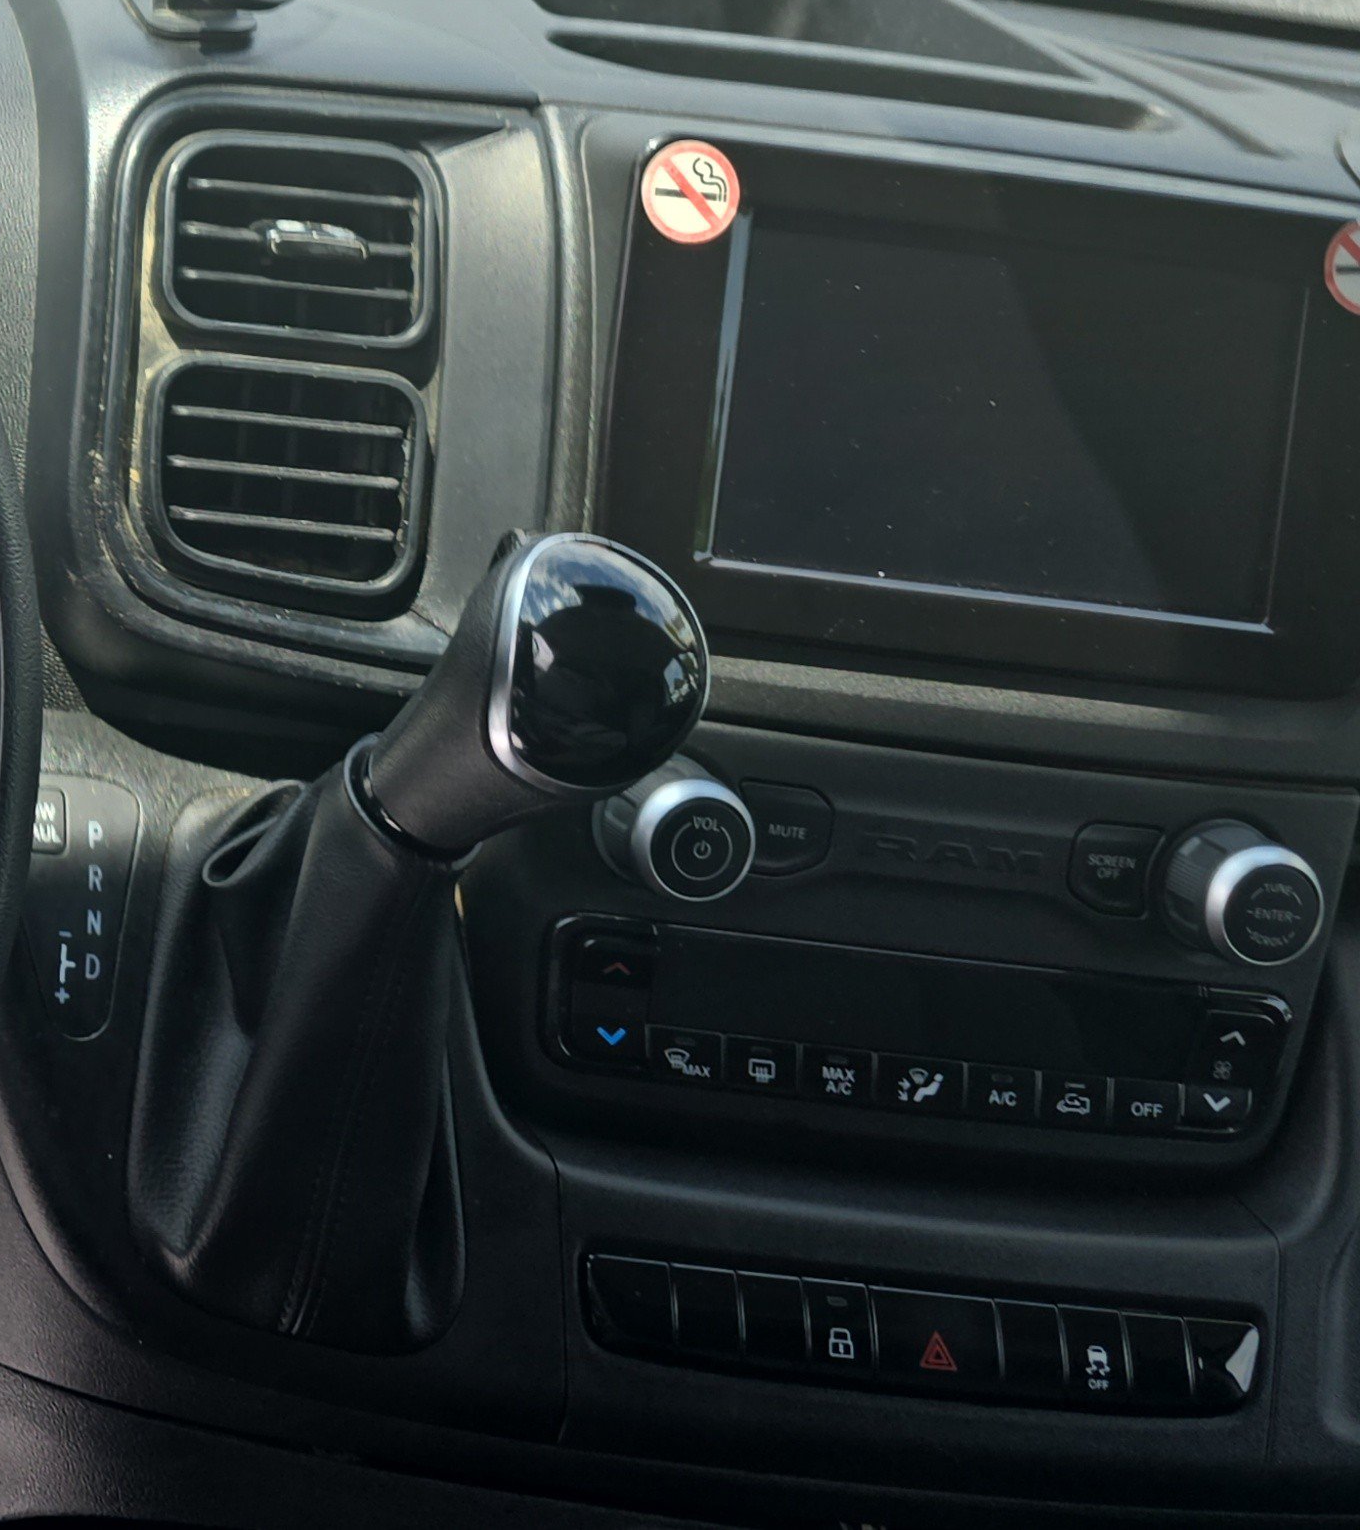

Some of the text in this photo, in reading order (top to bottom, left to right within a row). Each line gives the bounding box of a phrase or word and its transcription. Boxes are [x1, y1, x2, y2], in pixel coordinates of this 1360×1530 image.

[693, 816, 721, 832] VOL
[768, 824, 807, 840] MUTE
[88, 820, 103, 849] P
[863, 830, 1046, 872] RAM
[1088, 853, 1136, 869] SCREEN
[88, 864, 103, 892] R
[87, 910, 102, 936] N
[85, 954, 100, 979] D
[682, 1063, 711, 1078] MAX
[821, 1065, 856, 1083] MAX
[825, 1079, 853, 1096] A/C
[988, 1089, 1018, 1107] A/C
[1131, 1101, 1163, 1118] OFF
[1087, 1378, 1109, 1391] OFF
